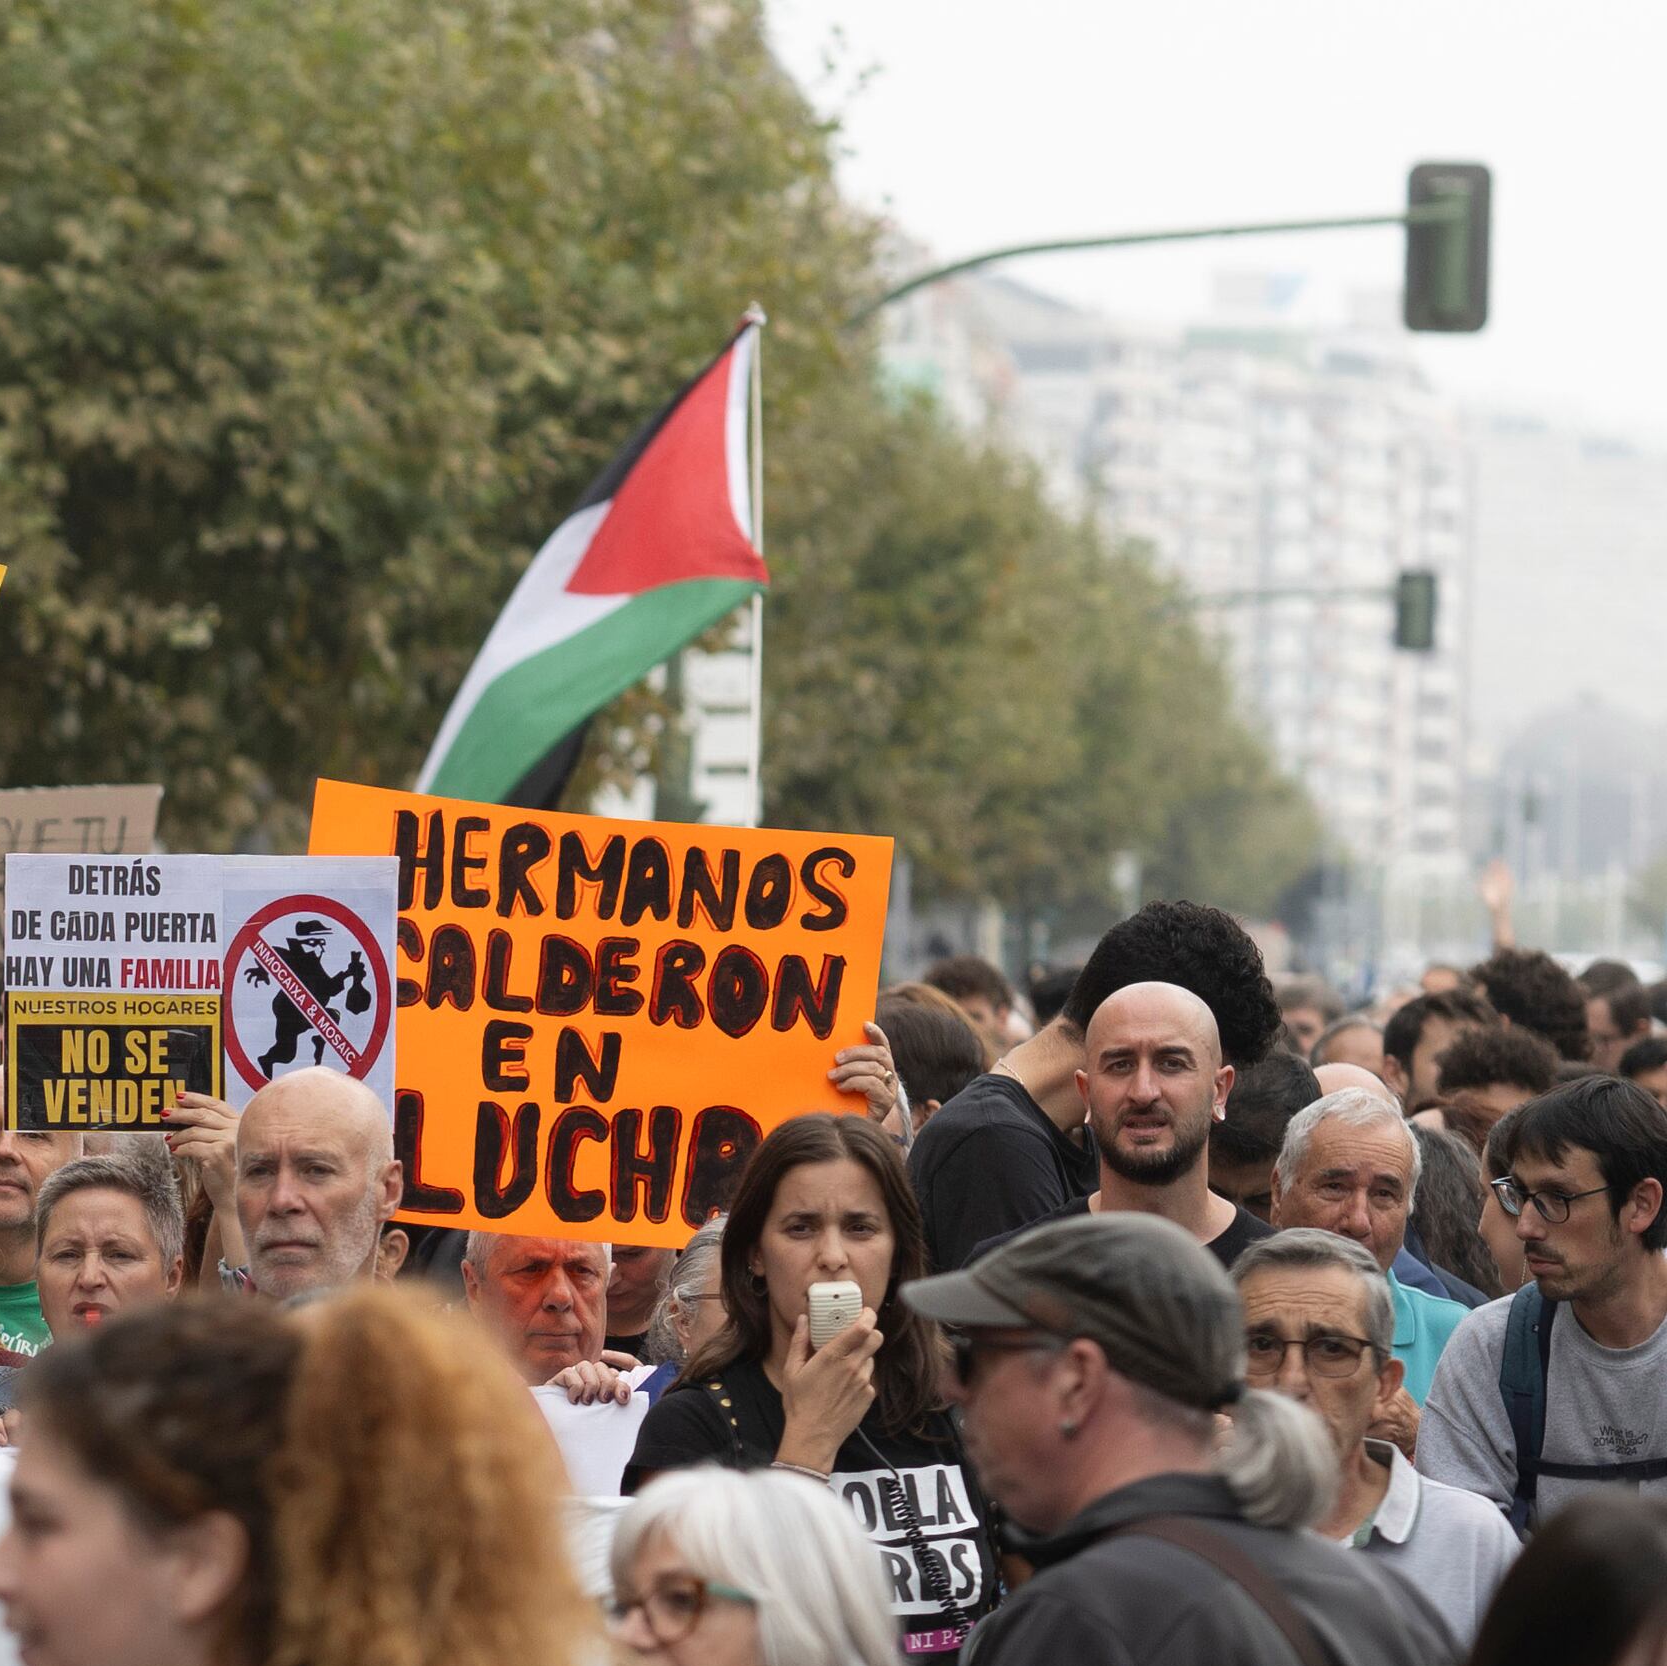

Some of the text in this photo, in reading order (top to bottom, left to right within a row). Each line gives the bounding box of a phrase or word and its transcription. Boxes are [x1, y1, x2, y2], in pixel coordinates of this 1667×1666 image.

[68, 858, 161, 896] DETRÁS
[393, 808, 857, 933] HERMANOS
[12, 910, 216, 943] DE CADA PUERTA
[6, 956, 221, 990] HAY UNA FAMILIA
[14, 1000, 218, 1016] NUESTROS HOGARES
[253, 939, 306, 1007] INMOCAIXA
[317, 1016, 357, 1065] MOSAIC
[61, 1029, 169, 1074] NO SE
[480, 1019, 622, 1103] EN
[43, 1079, 187, 1124] VENDEN
[394, 1088, 763, 1230] LUCHA
